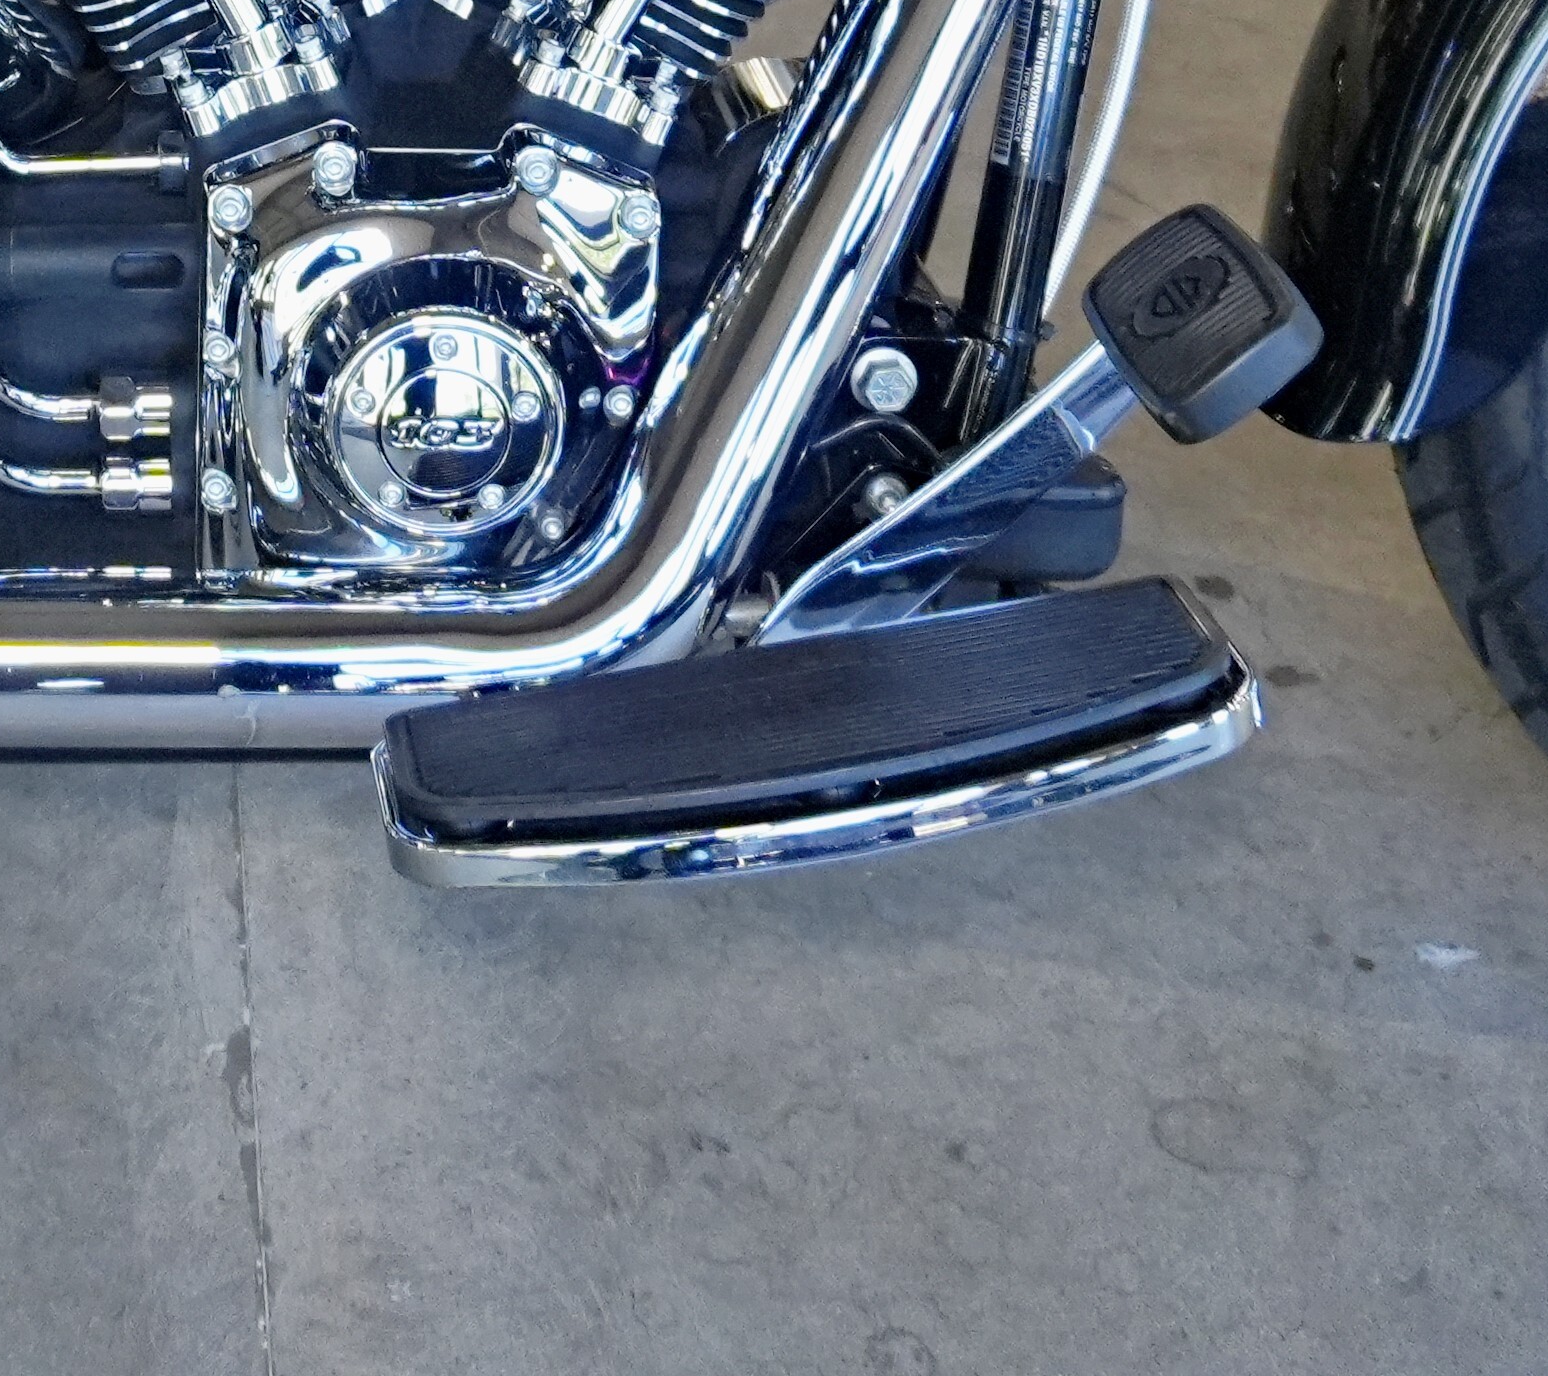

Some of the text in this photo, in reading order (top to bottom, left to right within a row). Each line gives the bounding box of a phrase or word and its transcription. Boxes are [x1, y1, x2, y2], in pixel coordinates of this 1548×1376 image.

[1055, 15, 1065, 28] US
[1049, 28, 1063, 64] FEDERAL
[1044, 63, 1057, 93] MOTOR
